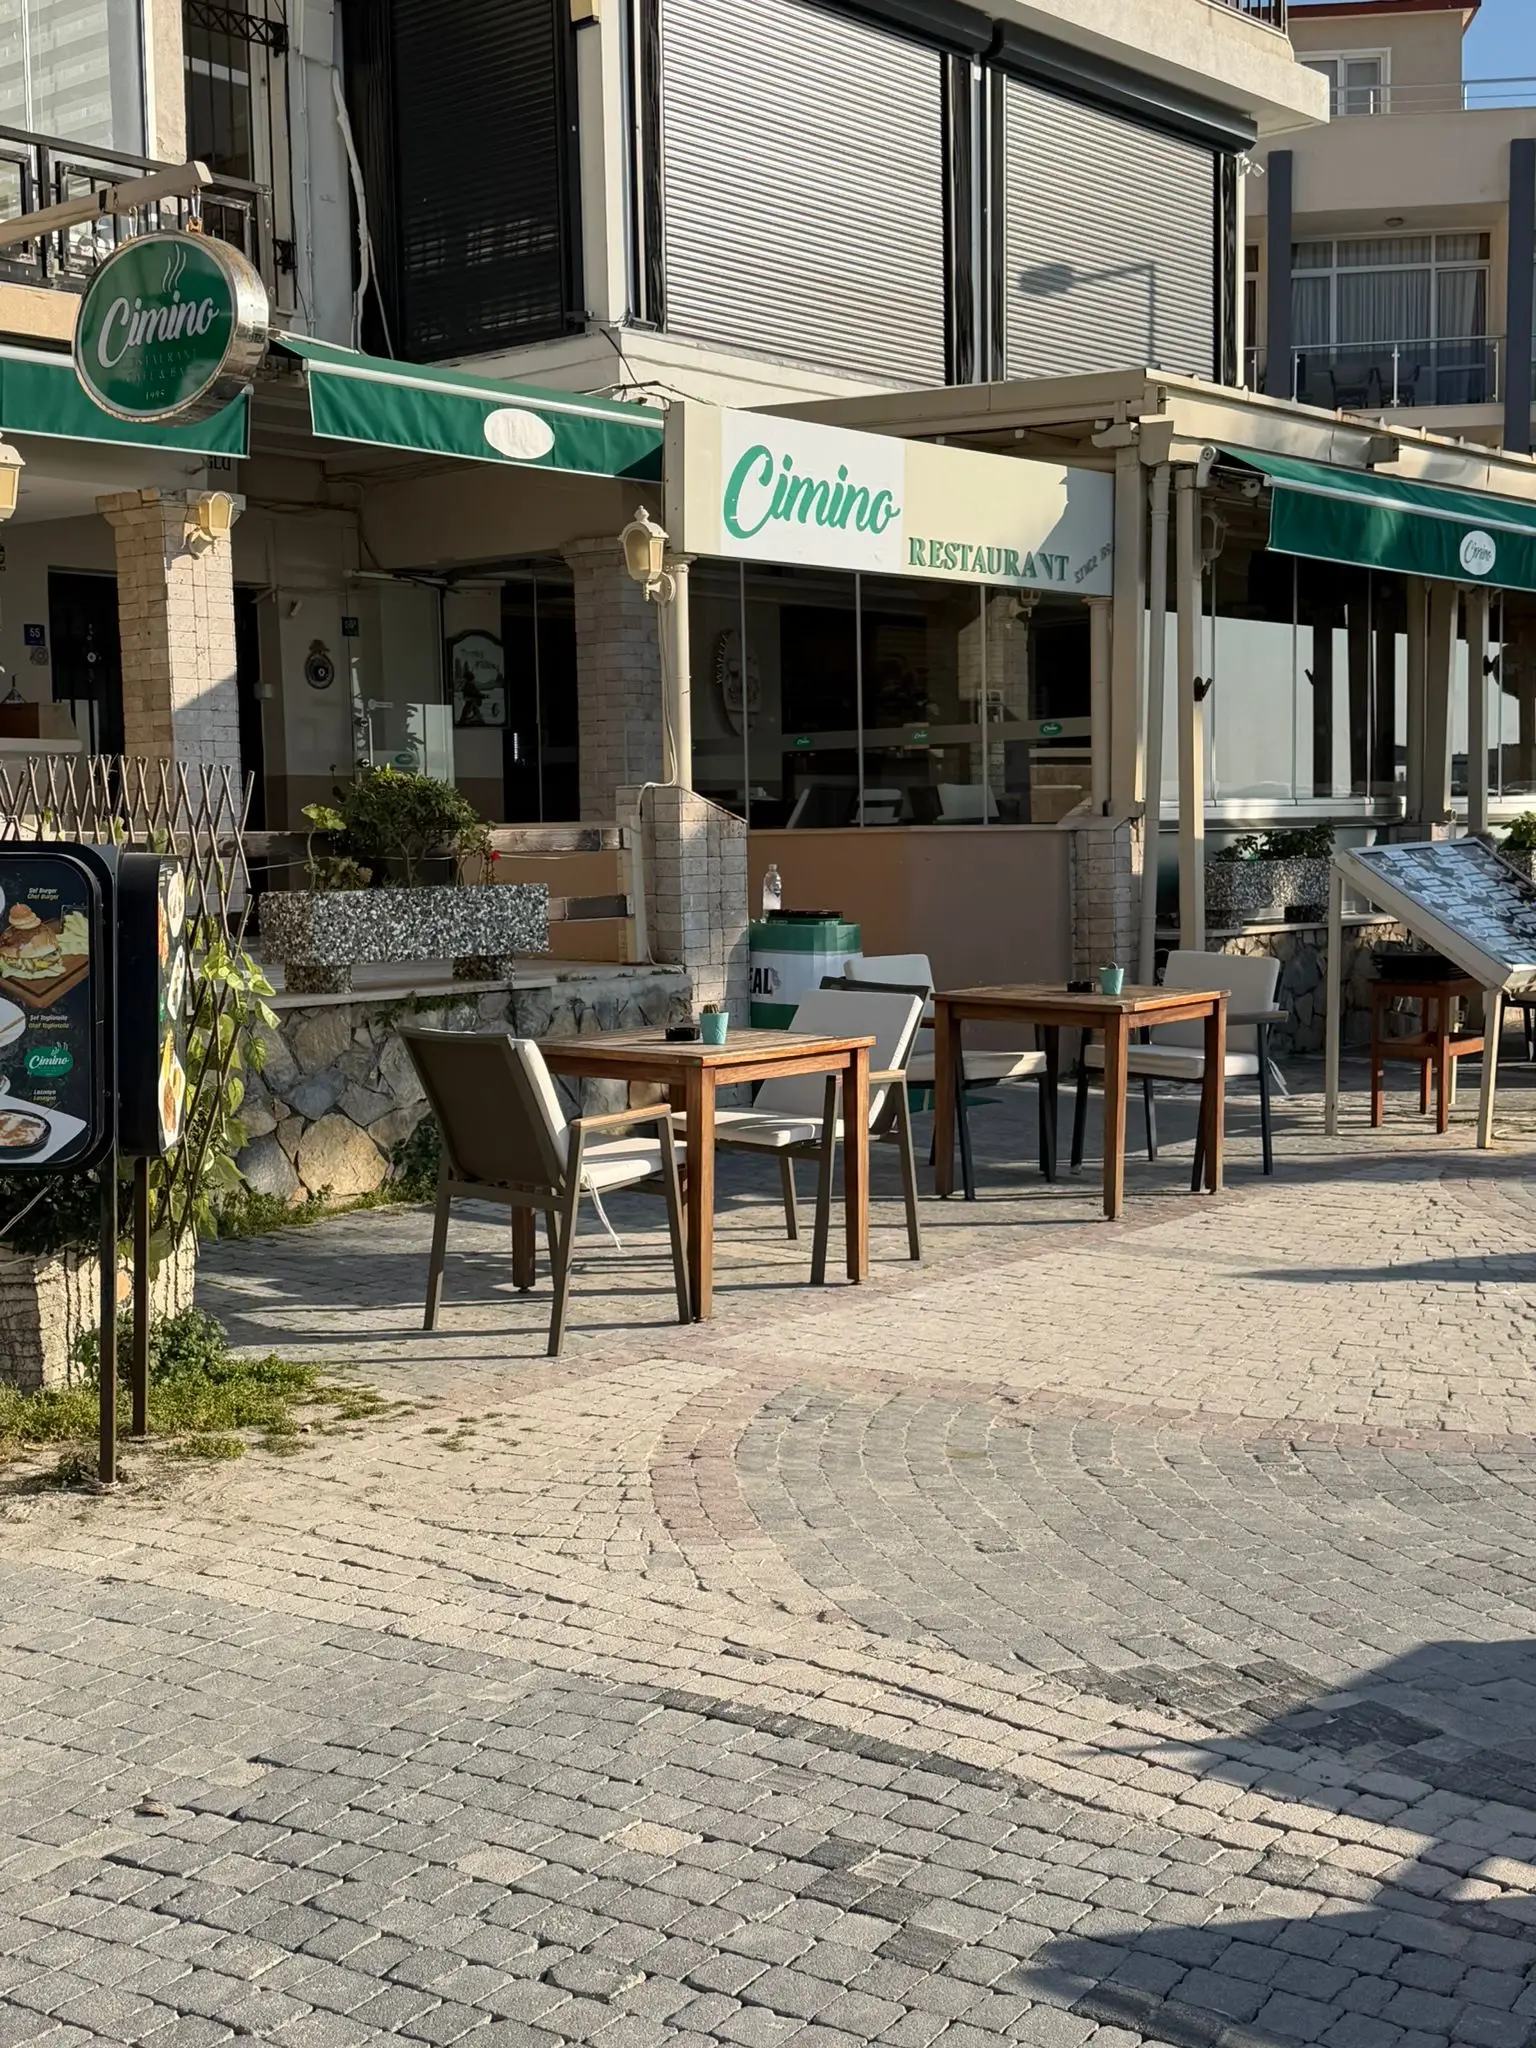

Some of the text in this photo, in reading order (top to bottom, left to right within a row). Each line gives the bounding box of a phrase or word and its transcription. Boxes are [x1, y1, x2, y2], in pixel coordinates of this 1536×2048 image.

[98, 290, 219, 368] Cimino
[723, 444, 900, 540] Cimino
[908, 536, 1069, 582] RESTAURANT
[29, 1055, 69, 1069] Cimino
